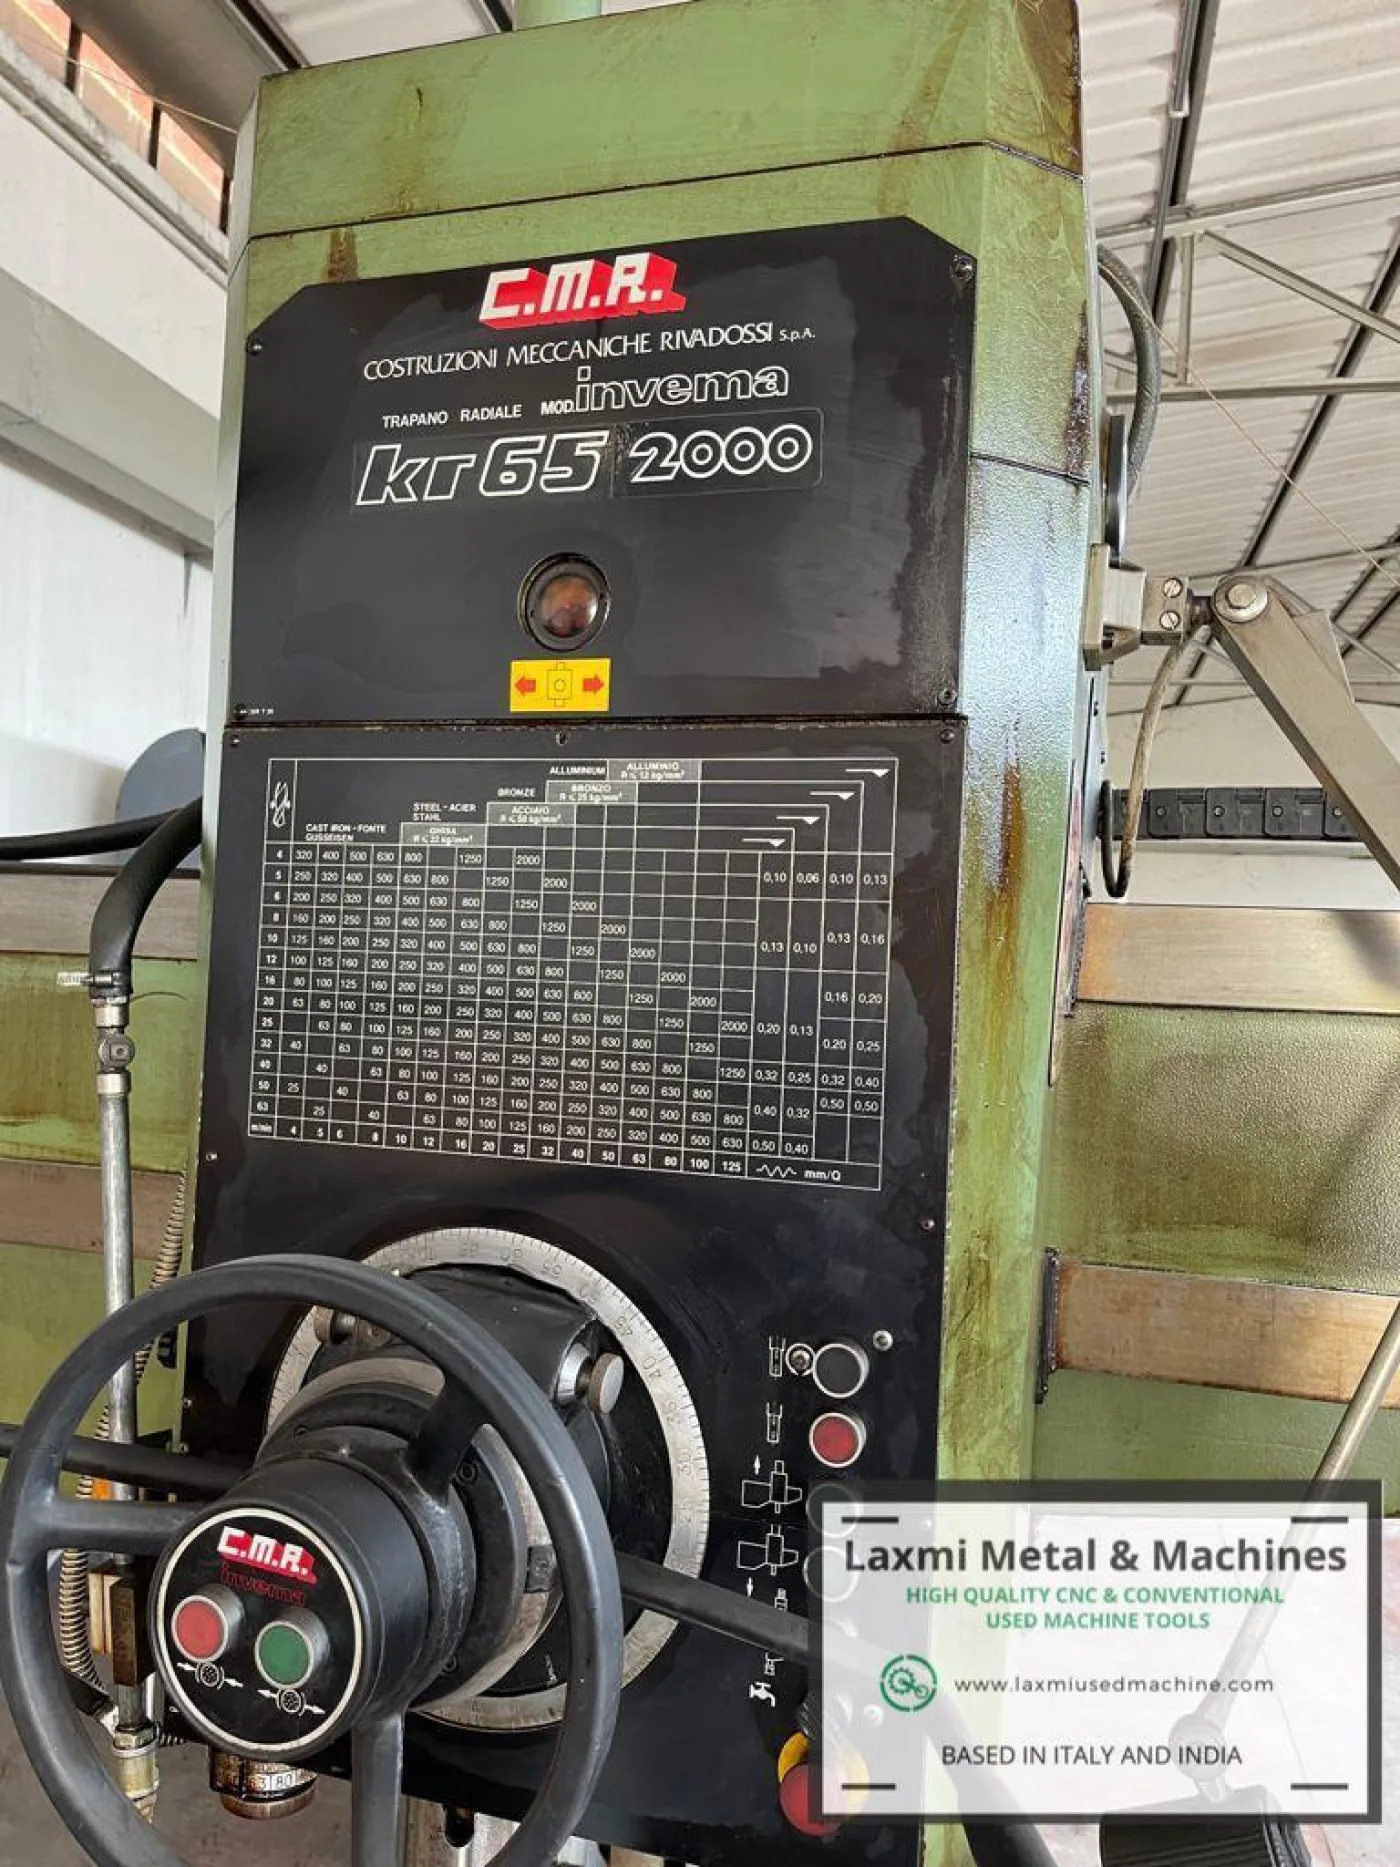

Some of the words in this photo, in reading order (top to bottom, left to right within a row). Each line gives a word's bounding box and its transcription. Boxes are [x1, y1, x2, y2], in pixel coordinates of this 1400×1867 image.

[479, 253, 675, 326] C.M.R.
[363, 348, 498, 380] COSTRUZIONI
[507, 332, 652, 367] MECCANICHE
[661, 322, 774, 352] RIVADOSSI
[779, 327, 816, 345] S.p.A.
[382, 410, 448, 429] TRAPANO
[460, 403, 523, 422] RADIALE
[541, 399, 576, 417] MOD.
[576, 363, 789, 413] invema
[629, 423, 812, 484] 2000
[413, 803, 441, 811] STEEL
[413, 813, 441, 821] STAHL
[306, 824, 328, 832] CAST
[295, 850, 312, 860] 320
[322, 851, 339, 860] 400
[350, 851, 366, 861] 500
[459, 854, 481, 863] 1250
[517, 855, 540, 865] 2000
[295, 871, 311, 881] 250
[321, 872, 338, 881] 320
[346, 873, 363, 882] 400
[376, 873, 392, 883] 500
[487, 876, 508, 886] 1250
[544, 878, 567, 888] 2000
[516, 899, 537, 909] 1250
[572, 901, 596, 911] 2000
[543, 922, 565, 932] 1250
[602, 924, 626, 934] 2000
[572, 946, 594, 956] 1250
[631, 948, 654, 958] 2000
[291, 956, 306, 965] 100
[318, 957, 333, 966] 125
[372, 959, 388, 969] 200
[427, 962, 444, 971] 320
[600, 970, 624, 980] 1250
[660, 972, 685, 982] 2000
[317, 978, 332, 988] 100
[341, 979, 357, 989] 125
[399, 982, 416, 992] 200
[630, 993, 653, 1003] 1250
[691, 997, 716, 1007] 2000
[340, 1001, 355, 1010] 100
[370, 1002, 386, 1012] 125
[425, 1005, 441, 1015] 200
[660, 1018, 684, 1029] 1250
[722, 1022, 747, 1032] 2000
[572, 1035, 591, 1045] 500
[690, 1043, 715, 1053] 1250
[570, 1058, 589, 1068] 400
[601, 1060, 619, 1070] 500
[720, 1068, 745, 1078] 1250
[600, 1083, 618, 1093] 400
[630, 1085, 649, 1095] 500
[629, 1108, 647, 1118] 400
[660, 1110, 679, 1121] 500
[691, 1135, 711, 1146] 500
[396, 1134, 407, 1144] 10
[423, 1136, 434, 1146] 12
[456, 1139, 467, 1149] 16
[483, 1141, 494, 1151] 20
[514, 1144, 525, 1154] 25
[541, 1146, 554, 1157] 32
[572, 1149, 584, 1159] 40
[602, 1151, 614, 1161] 50
[633, 1154, 646, 1164] 63
[665, 1156, 677, 1167] 80
[690, 1158, 709, 1169] 100
[722, 1161, 741, 1172] 125
[218, 1526, 315, 1580] C.M.R.
